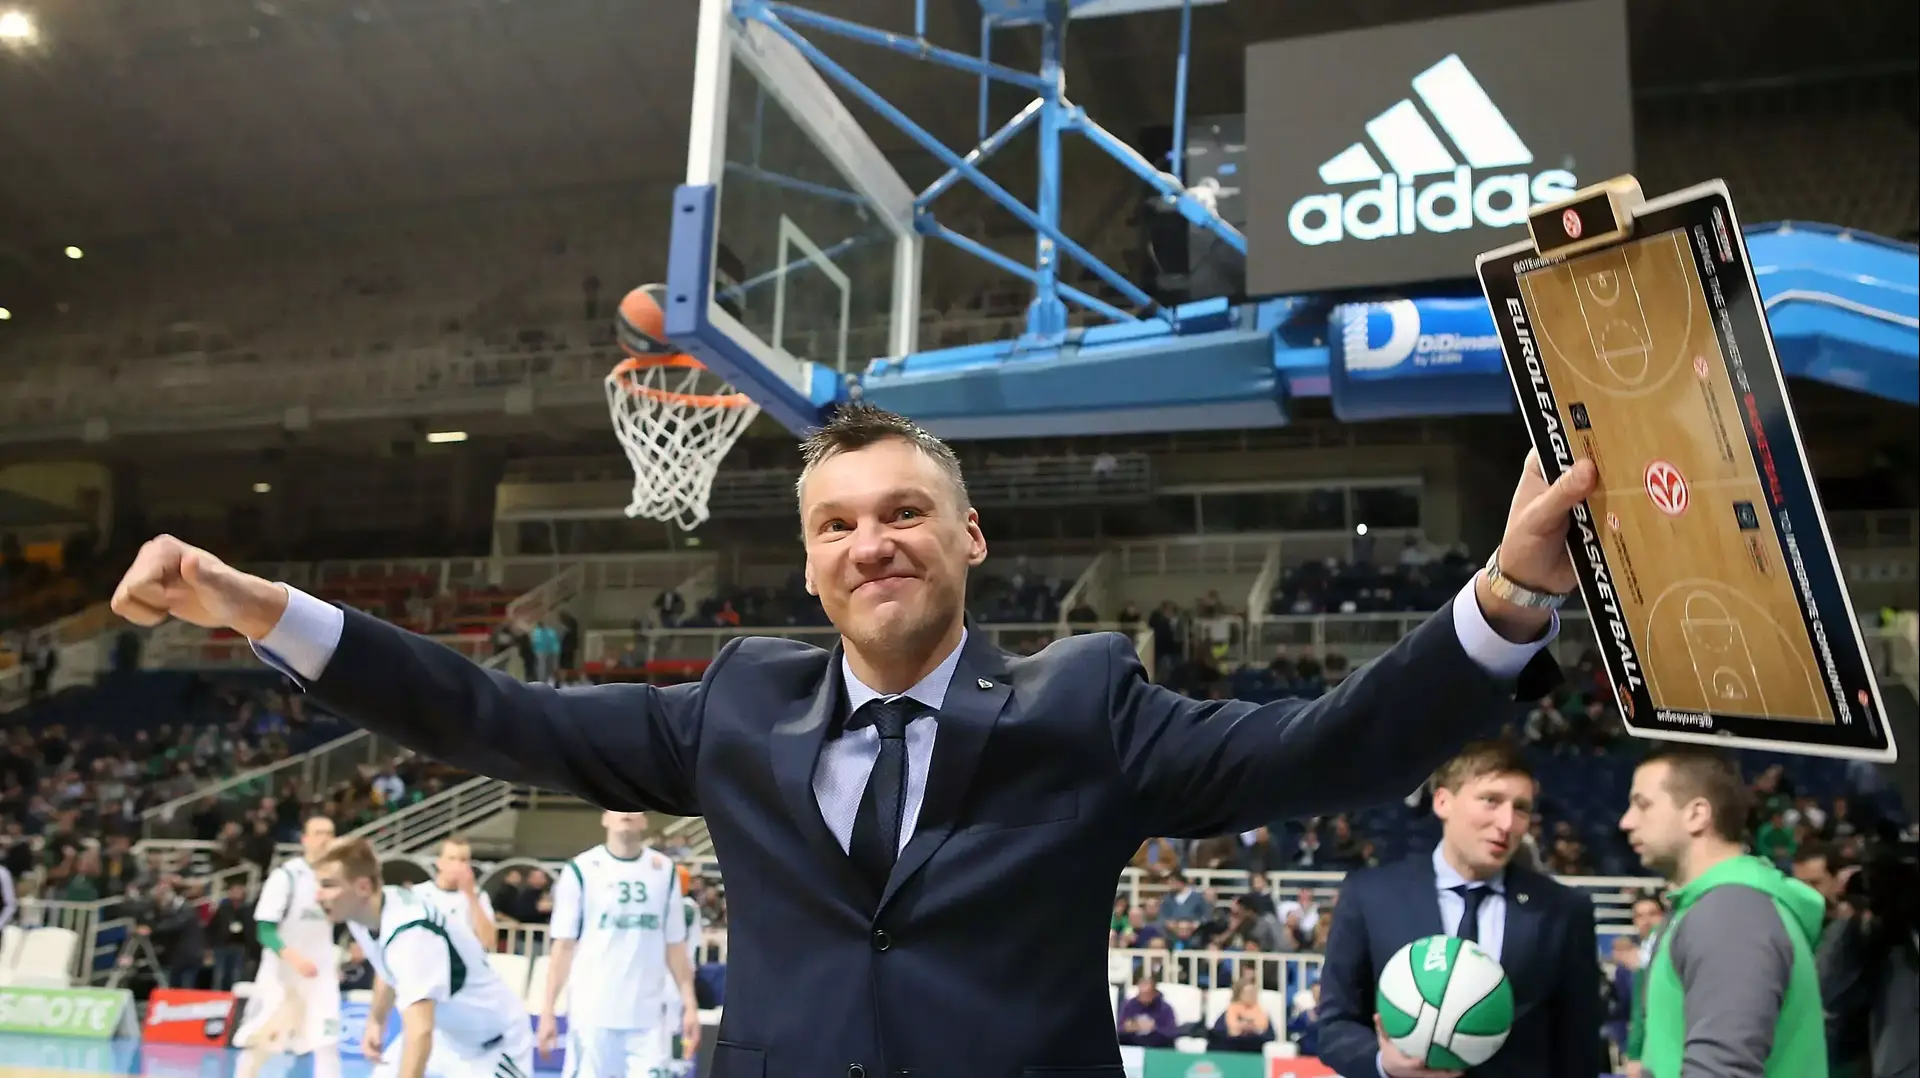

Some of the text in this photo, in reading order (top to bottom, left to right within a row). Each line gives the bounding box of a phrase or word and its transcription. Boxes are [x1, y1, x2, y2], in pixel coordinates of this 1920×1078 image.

[1289, 165, 1578, 246] adidas
[1709, 275, 1726, 309] THE
[1506, 298, 1572, 472] EUROLEAGU
[1572, 503, 1642, 692] BASKETBALL
[1779, 508, 1792, 534] TO
[1785, 533, 1819, 620] INTEGRATE
[1813, 619, 1852, 725] COMMUNITIES
[618, 881, 648, 904] 33
